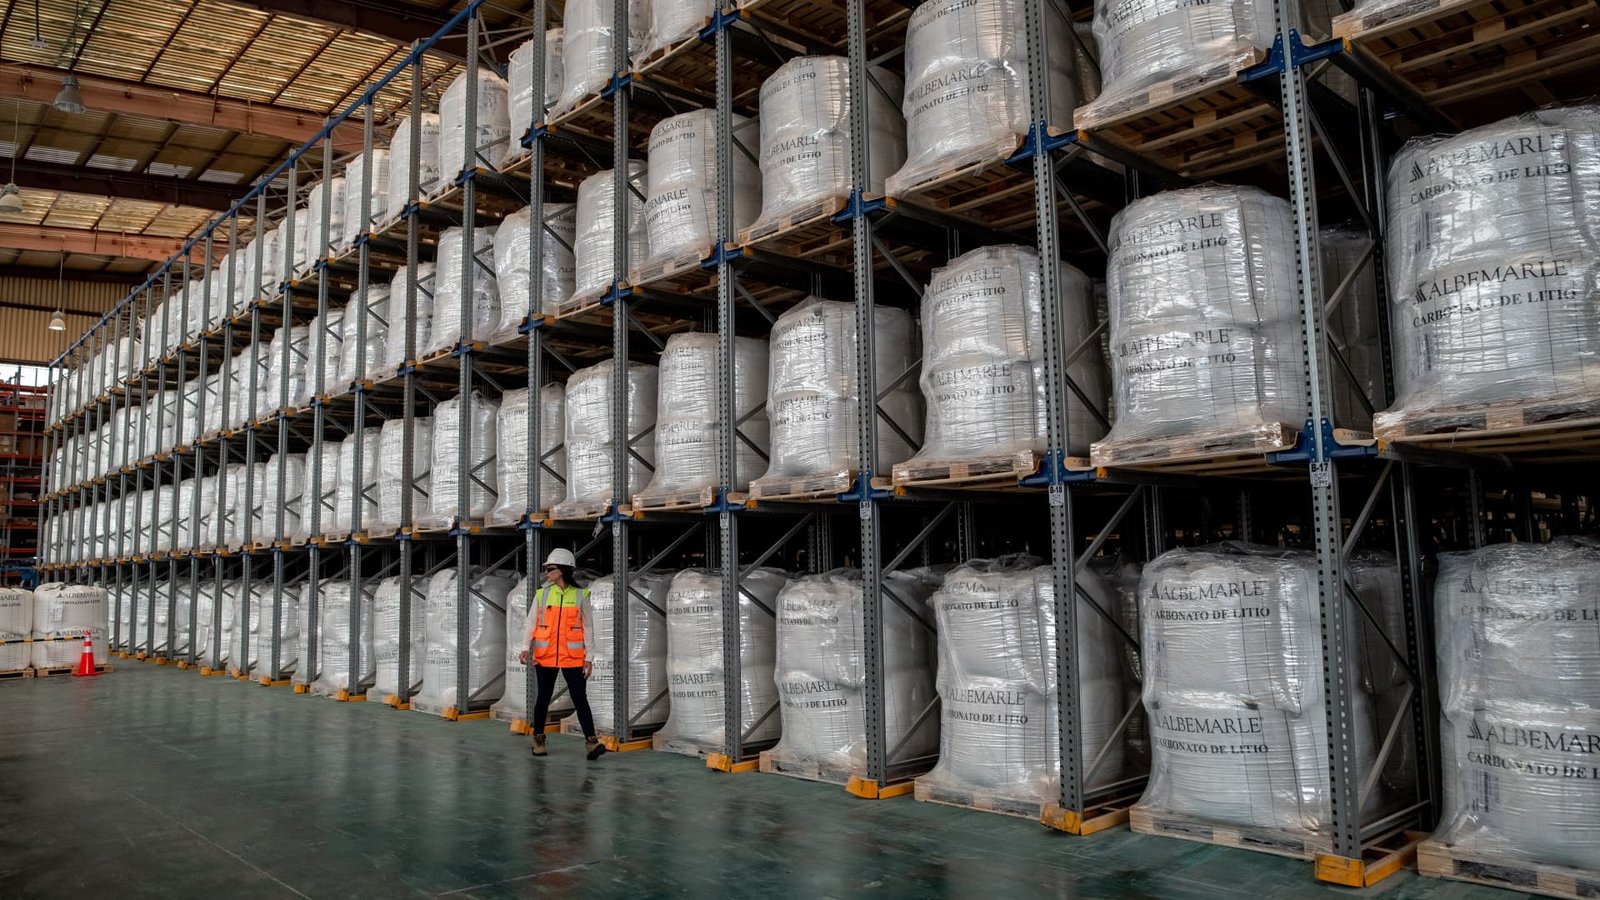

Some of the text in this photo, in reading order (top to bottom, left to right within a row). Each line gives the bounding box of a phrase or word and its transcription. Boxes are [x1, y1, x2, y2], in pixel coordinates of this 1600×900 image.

[1498, 167, 1521, 183] DE
[1525, 162, 1572, 179] LITIO
[1191, 236, 1228, 251] LITIO
[1429, 259, 1568, 300] ALBEMARLE
[1413, 288, 1577, 329] CARBOATO DE LITIO
[1129, 328, 1231, 356] ALBEARLE
[1201, 352, 1236, 366] ITIO
[1311, 462, 1329, 472] B-17
[1160, 580, 1266, 601] ALBEMARLE
[1150, 607, 1270, 621] CARBONATO DE LITIO
[1554, 609, 1577, 621] DE
[822, 698, 848, 708] LITIO
[948, 687, 1026, 706] ALBEMARLE
[982, 713, 996, 723] DE
[1162, 715, 1262, 734] ALBEMARLE
[1157, 738, 1269, 754] ARBONATO DE LITIO
[1563, 765, 1587, 779] DE
